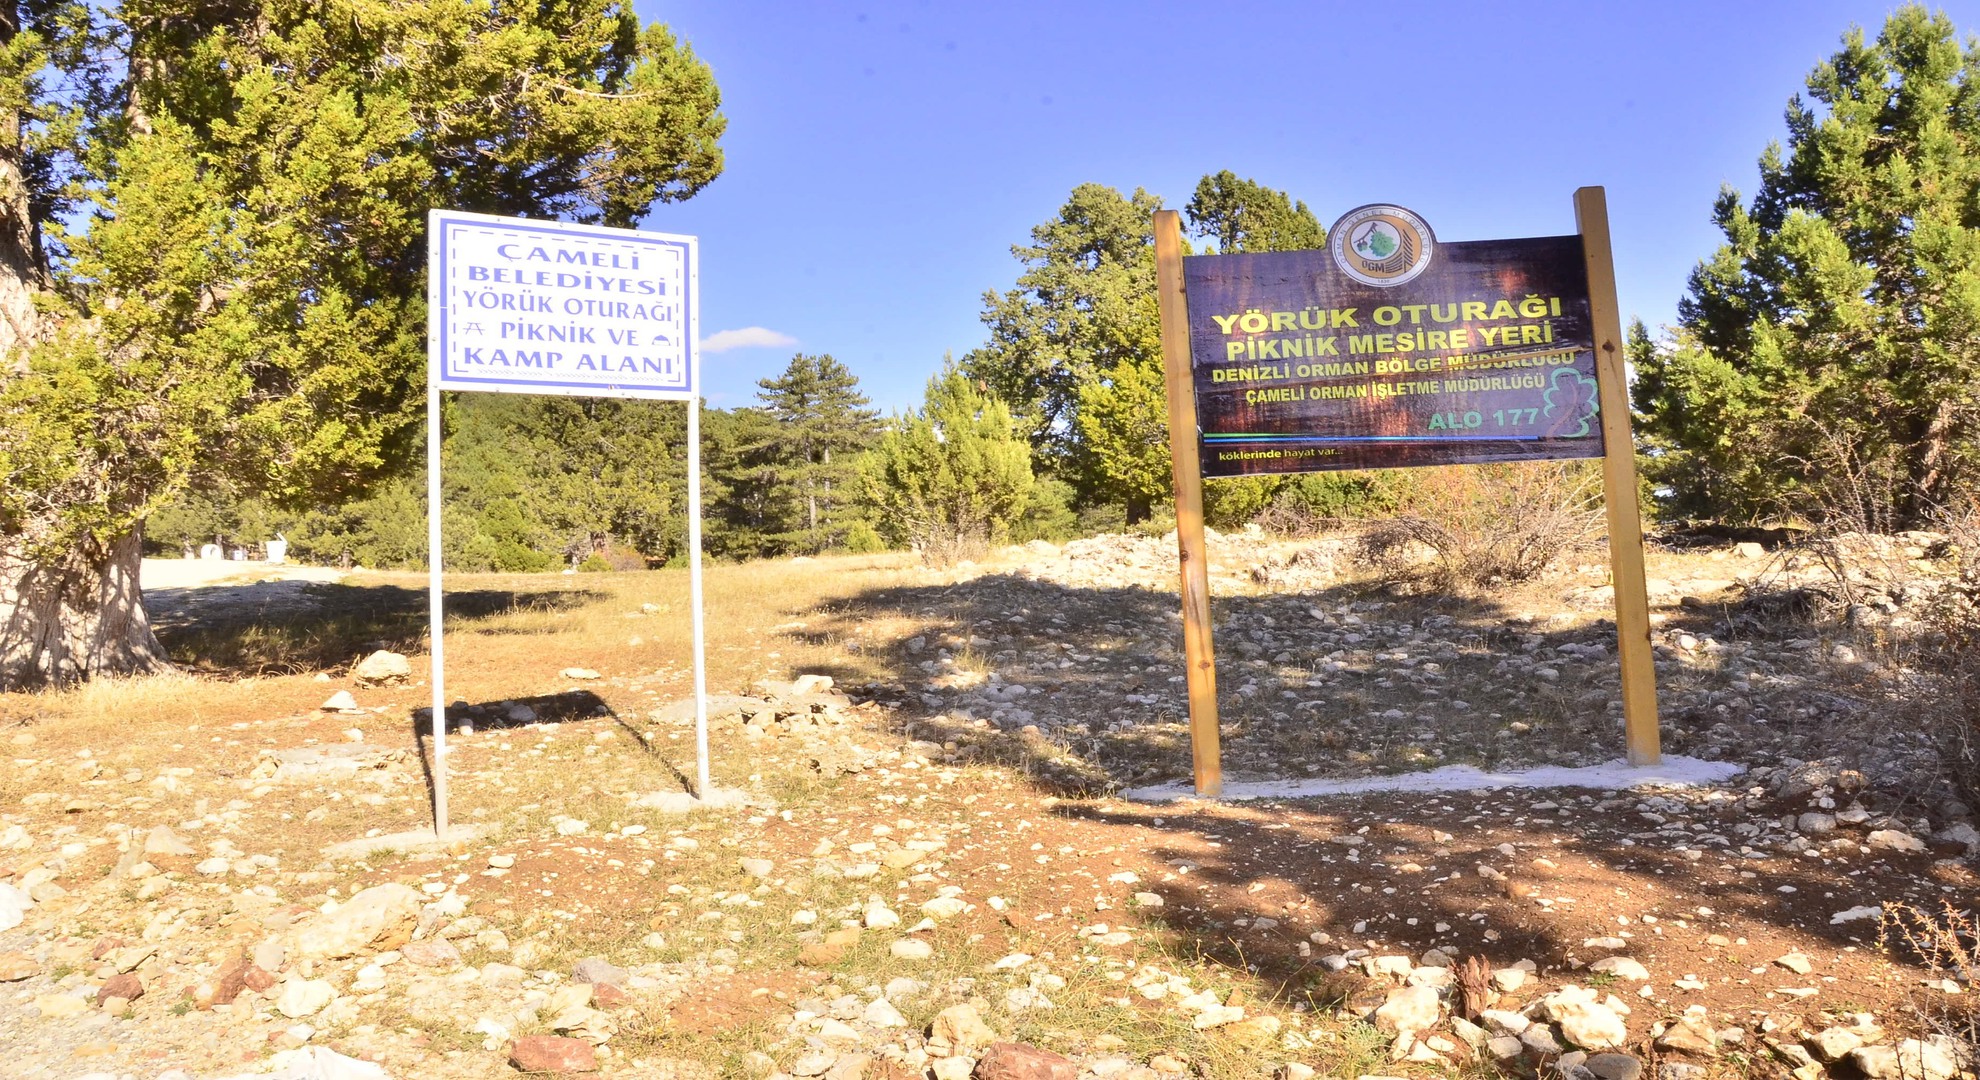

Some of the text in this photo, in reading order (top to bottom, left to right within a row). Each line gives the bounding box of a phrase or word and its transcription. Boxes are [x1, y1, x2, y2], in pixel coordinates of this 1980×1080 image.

[497, 243, 639, 270] ÇAMELİ
[1361, 260, 1385, 273] OGM
[468, 265, 666, 296] BELEDİYESİ
[463, 286, 672, 322] YÖRÜK OTURAĞI
[1211, 294, 1562, 335] YÖRÜK OTURAĞI
[501, 317, 639, 346] PİKNİK VE
[1226, 320, 1553, 361] PİKNİK MESİRE YERİ
[464, 347, 672, 375] KAMP ALANI
[1212, 348, 1575, 383] DENİZLİ ORMAN BÖLGE MÜDÜRLÜĞÜ
[1246, 373, 1545, 406] ÇAMELİ ORMAN İŞLETME MÜDÜRLÜĞÜ
[1428, 408, 1539, 430] ALO 177
[1219, 450, 1281, 460] köklerinde
[1284, 449, 1315, 458] hayat
